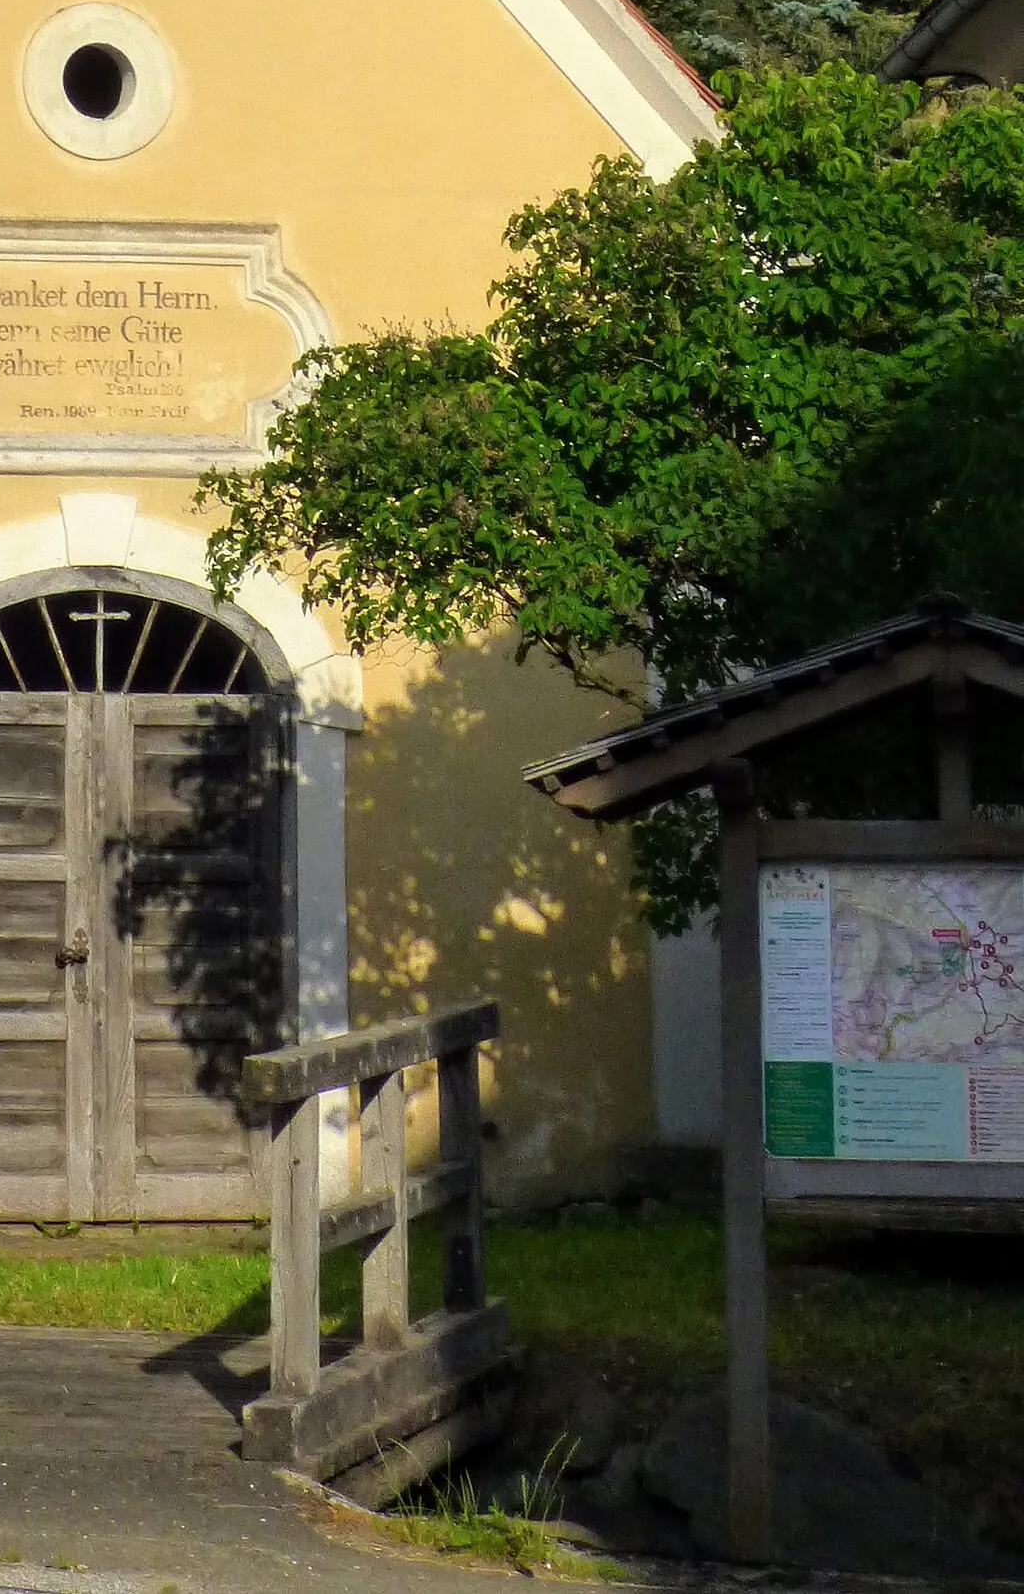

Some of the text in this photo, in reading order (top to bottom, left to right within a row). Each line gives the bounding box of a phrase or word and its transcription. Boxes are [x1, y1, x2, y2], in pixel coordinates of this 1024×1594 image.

[75, 280, 129, 309] dem
[50, 319, 111, 343] seine
[120, 315, 183, 343] Güte
[74, 349, 184, 383] ewiglich!
